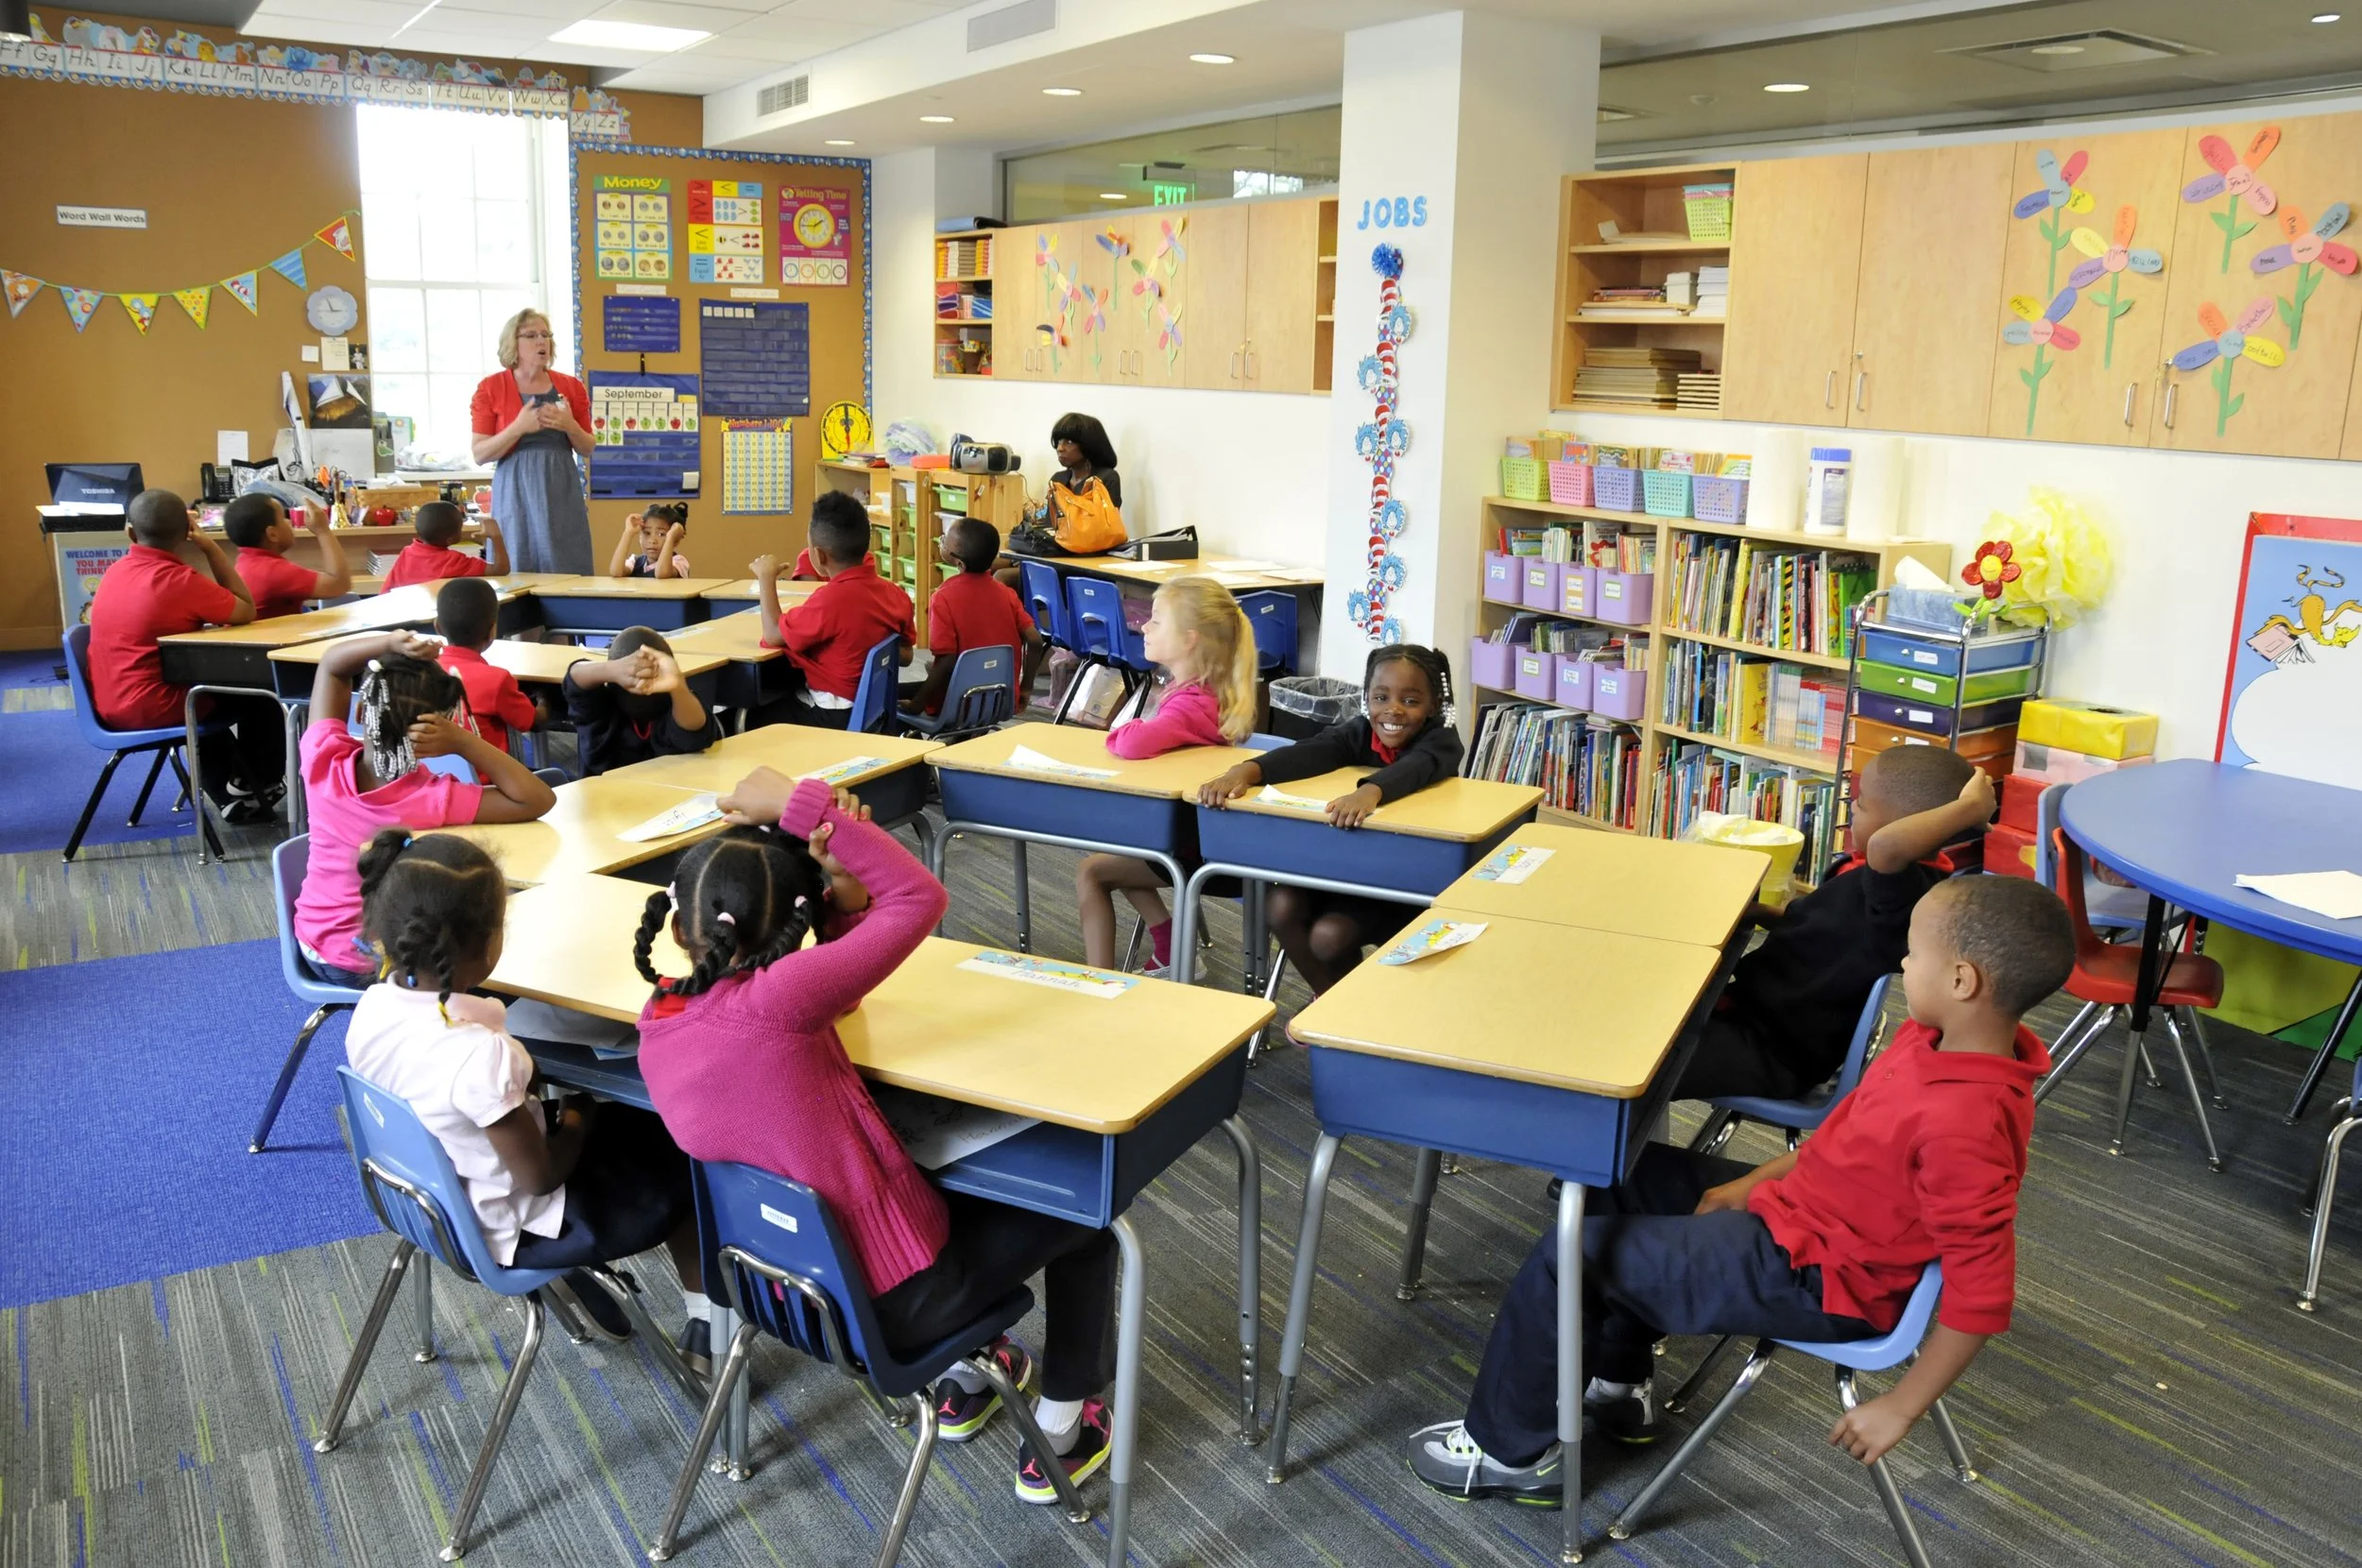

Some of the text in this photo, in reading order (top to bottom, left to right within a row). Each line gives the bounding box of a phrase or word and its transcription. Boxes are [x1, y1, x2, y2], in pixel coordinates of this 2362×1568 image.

[69, 47, 96, 67] Hh
[107, 53, 123, 69] Ii
[136, 58, 155, 79] Jj
[223, 65, 255, 82] Mm
[261, 69, 284, 84] Nn
[292, 71, 311, 87] Oo
[320, 75, 338, 90] Pp
[351, 76, 371, 101] Qq
[380, 78, 400, 94] Rr
[406, 80, 422, 95] Ss
[487, 88, 505, 102] Vv
[513, 90, 541, 104] Ww
[546, 92, 567, 106] Xx
[604, 177, 661, 190] Money
[796, 188, 847, 201] Telling Time
[59, 211, 145, 223] Word Wall Words
[1357, 195, 1428, 230] JOBS
[605, 388, 663, 400] September
[728, 418, 762, 429] Numbers
[66, 550, 109, 559] WELCOME
[77, 559, 94, 568] YOU
